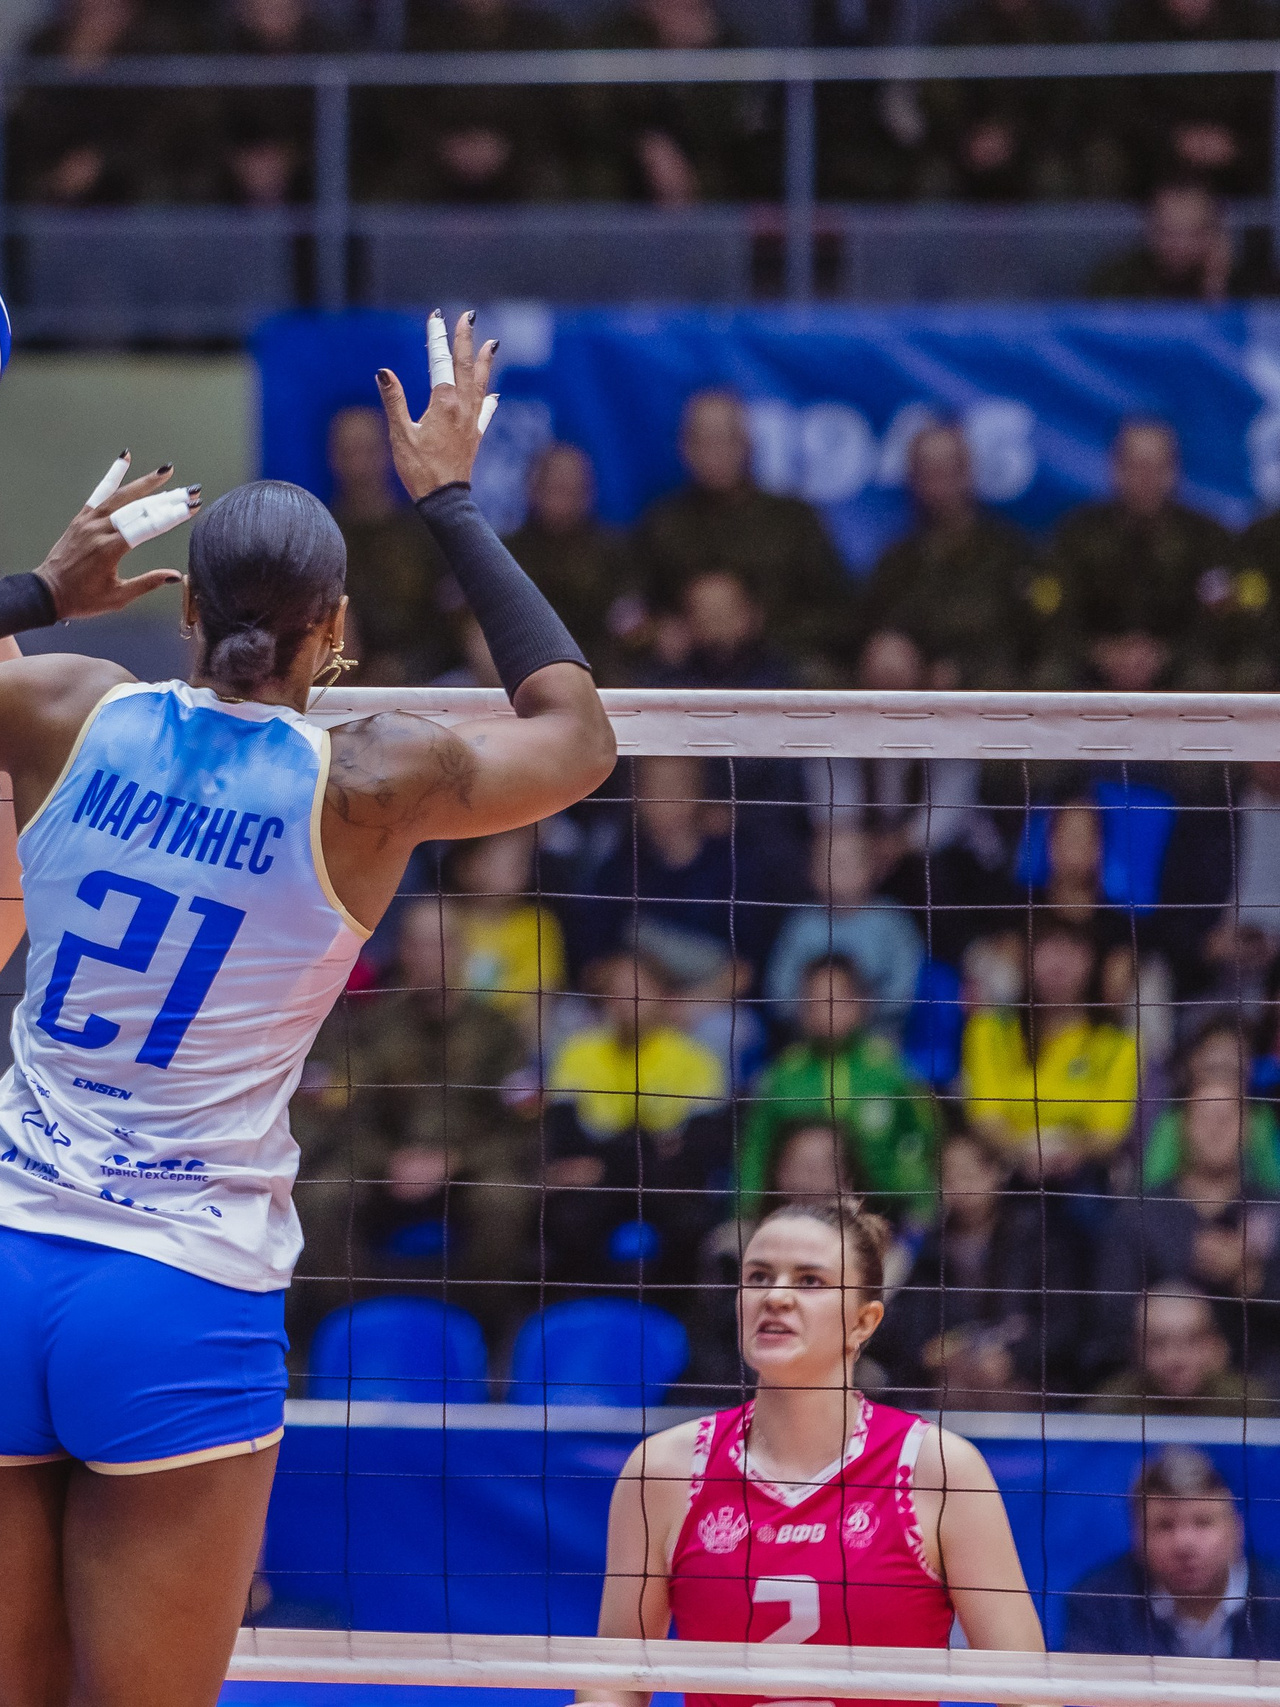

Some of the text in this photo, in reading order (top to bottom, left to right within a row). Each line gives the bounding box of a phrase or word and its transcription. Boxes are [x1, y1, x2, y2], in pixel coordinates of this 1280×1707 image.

[72, 769, 284, 875] МАРТИНЕС
[36, 870, 247, 1069] 21
[72, 1077, 133, 1101] ENSEN
[100, 1165, 209, 1182] ТрансТехСервис
[775, 1523, 827, 1544] ВФВ
